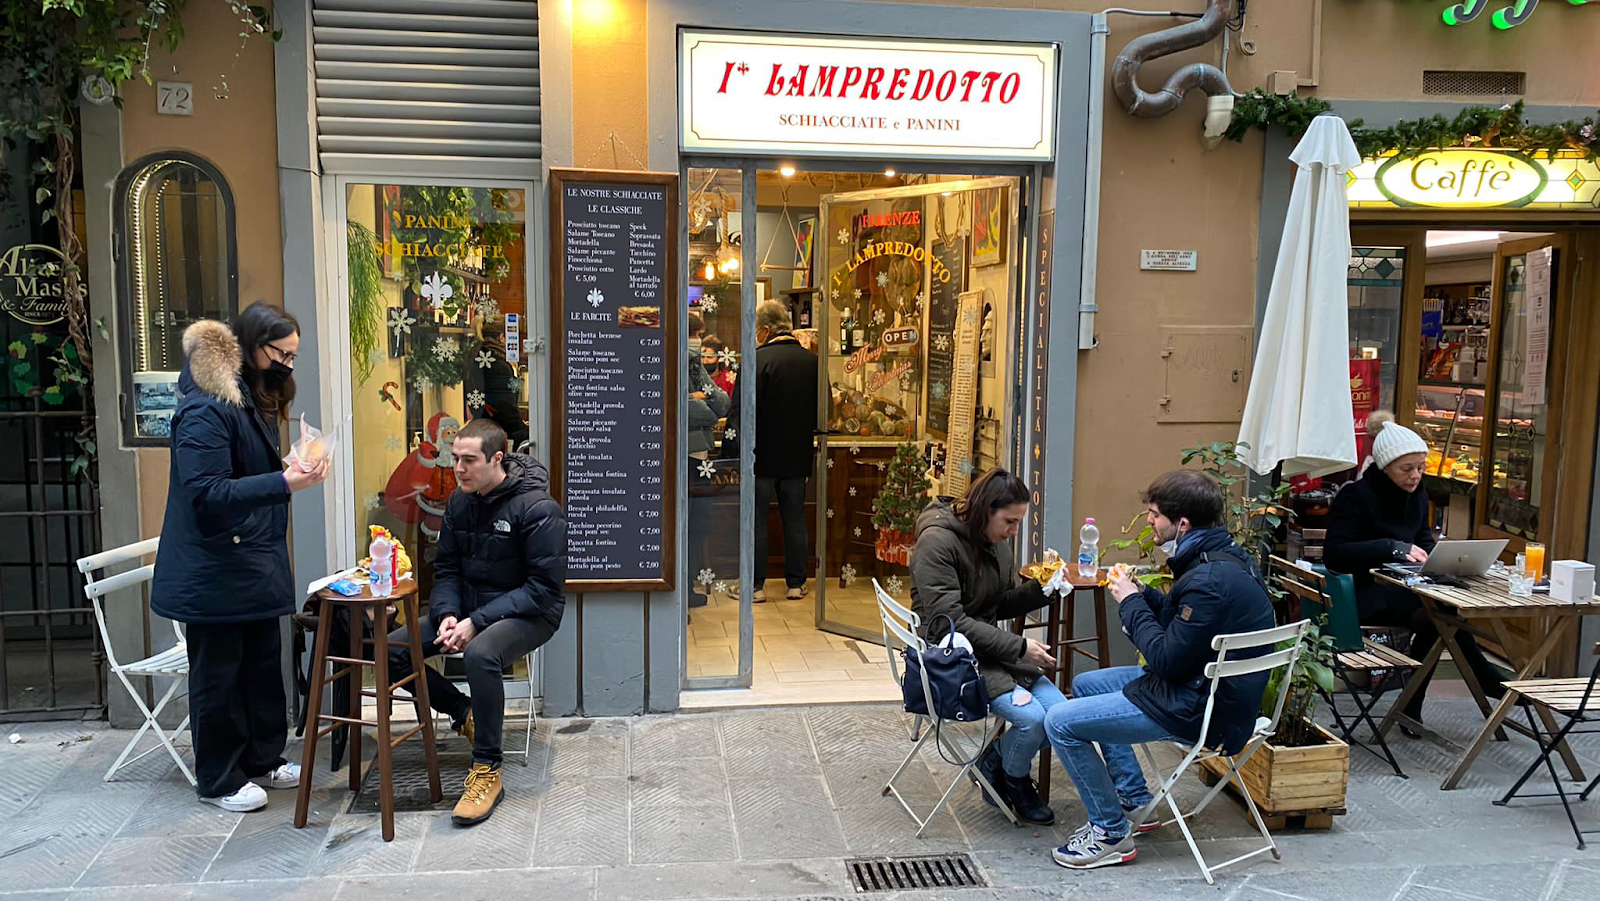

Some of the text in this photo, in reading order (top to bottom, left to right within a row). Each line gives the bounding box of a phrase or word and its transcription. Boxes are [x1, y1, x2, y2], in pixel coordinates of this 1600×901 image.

[764, 62, 1020, 104] LAMPREDOTTO
[162, 88, 189, 109] 72
[778, 114, 960, 131] SCHIACCIATE e PANINI
[1411, 158, 1516, 198] Caffè
[580, 189, 610, 198] NOSTRE
[613, 190, 662, 200] SCHIACCIATE
[600, 205, 642, 214] CLASSICHE
[406, 214, 470, 228] PANINI
[630, 223, 647, 231] Speck
[862, 210, 921, 228] FIRENZE
[630, 232, 661, 240] Soprassata
[375, 242, 504, 258] SCHIACCIATE
[845, 241, 950, 283] LAMPREDOTTO
[15, 277, 88, 298] Mass
[582, 312, 612, 321] FARCITE
[885, 330, 916, 342] OPEN
